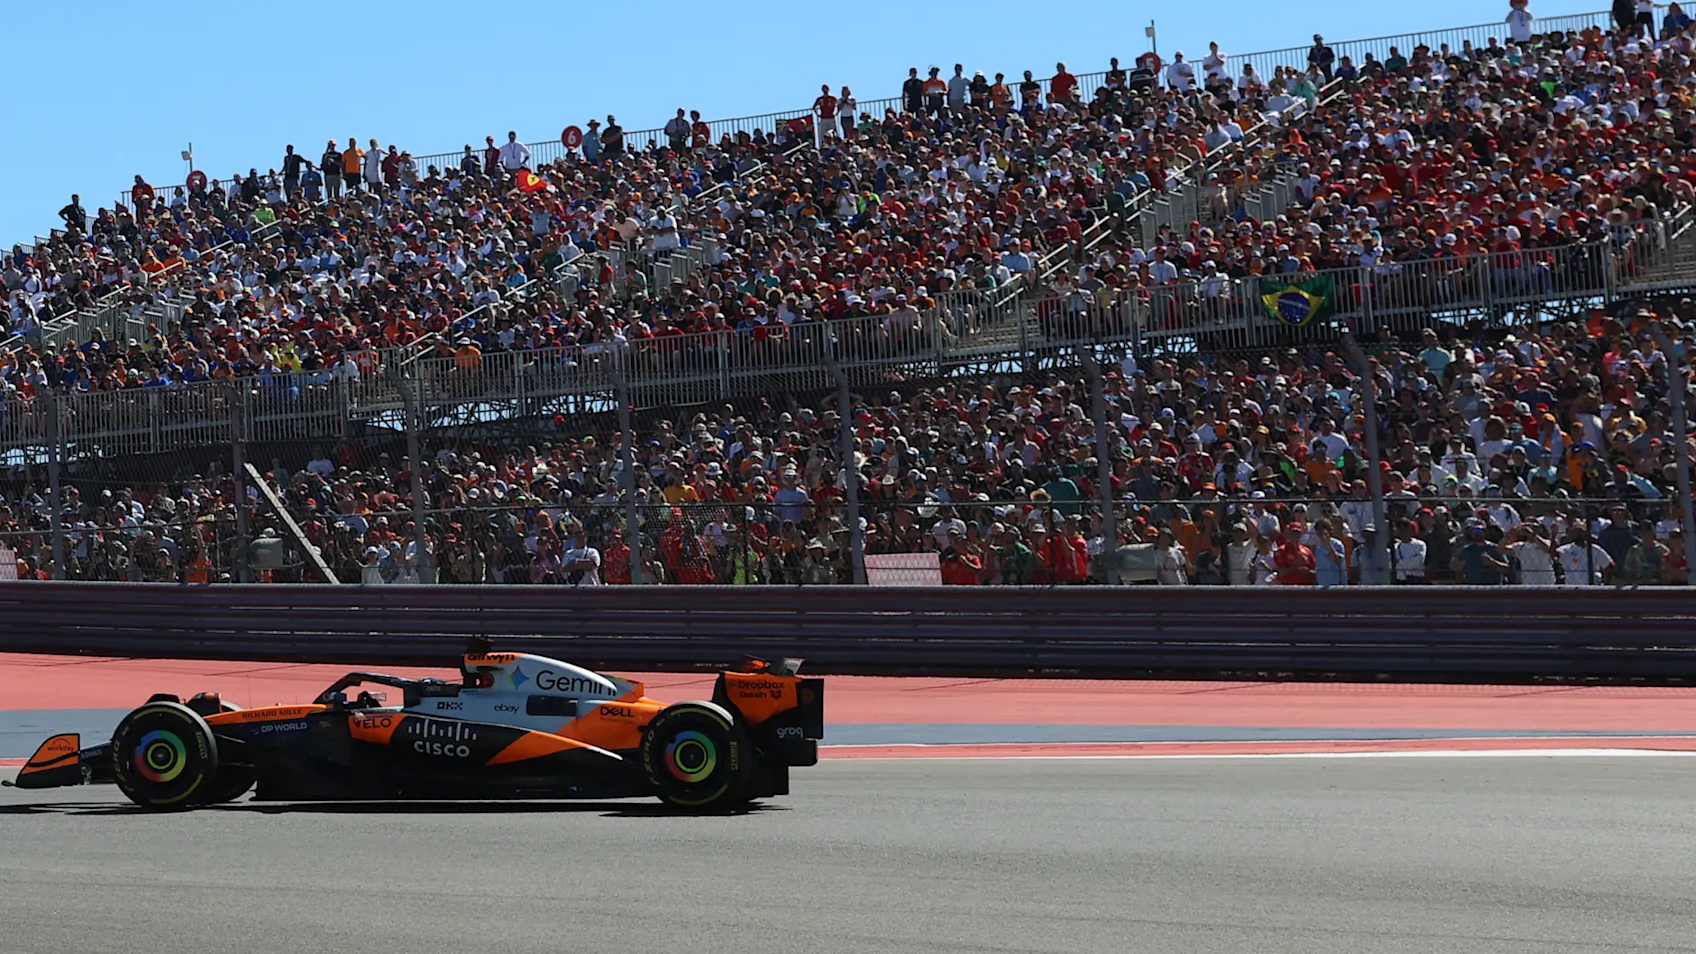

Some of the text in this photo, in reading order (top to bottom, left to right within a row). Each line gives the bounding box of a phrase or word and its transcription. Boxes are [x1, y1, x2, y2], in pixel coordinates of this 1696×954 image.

[567, 130, 577, 145] 6
[739, 680, 784, 691] Dropbox
[437, 701, 463, 710] OKX
[493, 703, 520, 714] ebay
[242, 710, 277, 719] RICHARD
[600, 706, 635, 717] DELL
[261, 725, 274, 733] DP
[274, 722, 308, 732] WORLD
[354, 718, 392, 729] VELO
[777, 727, 804, 738] groq
